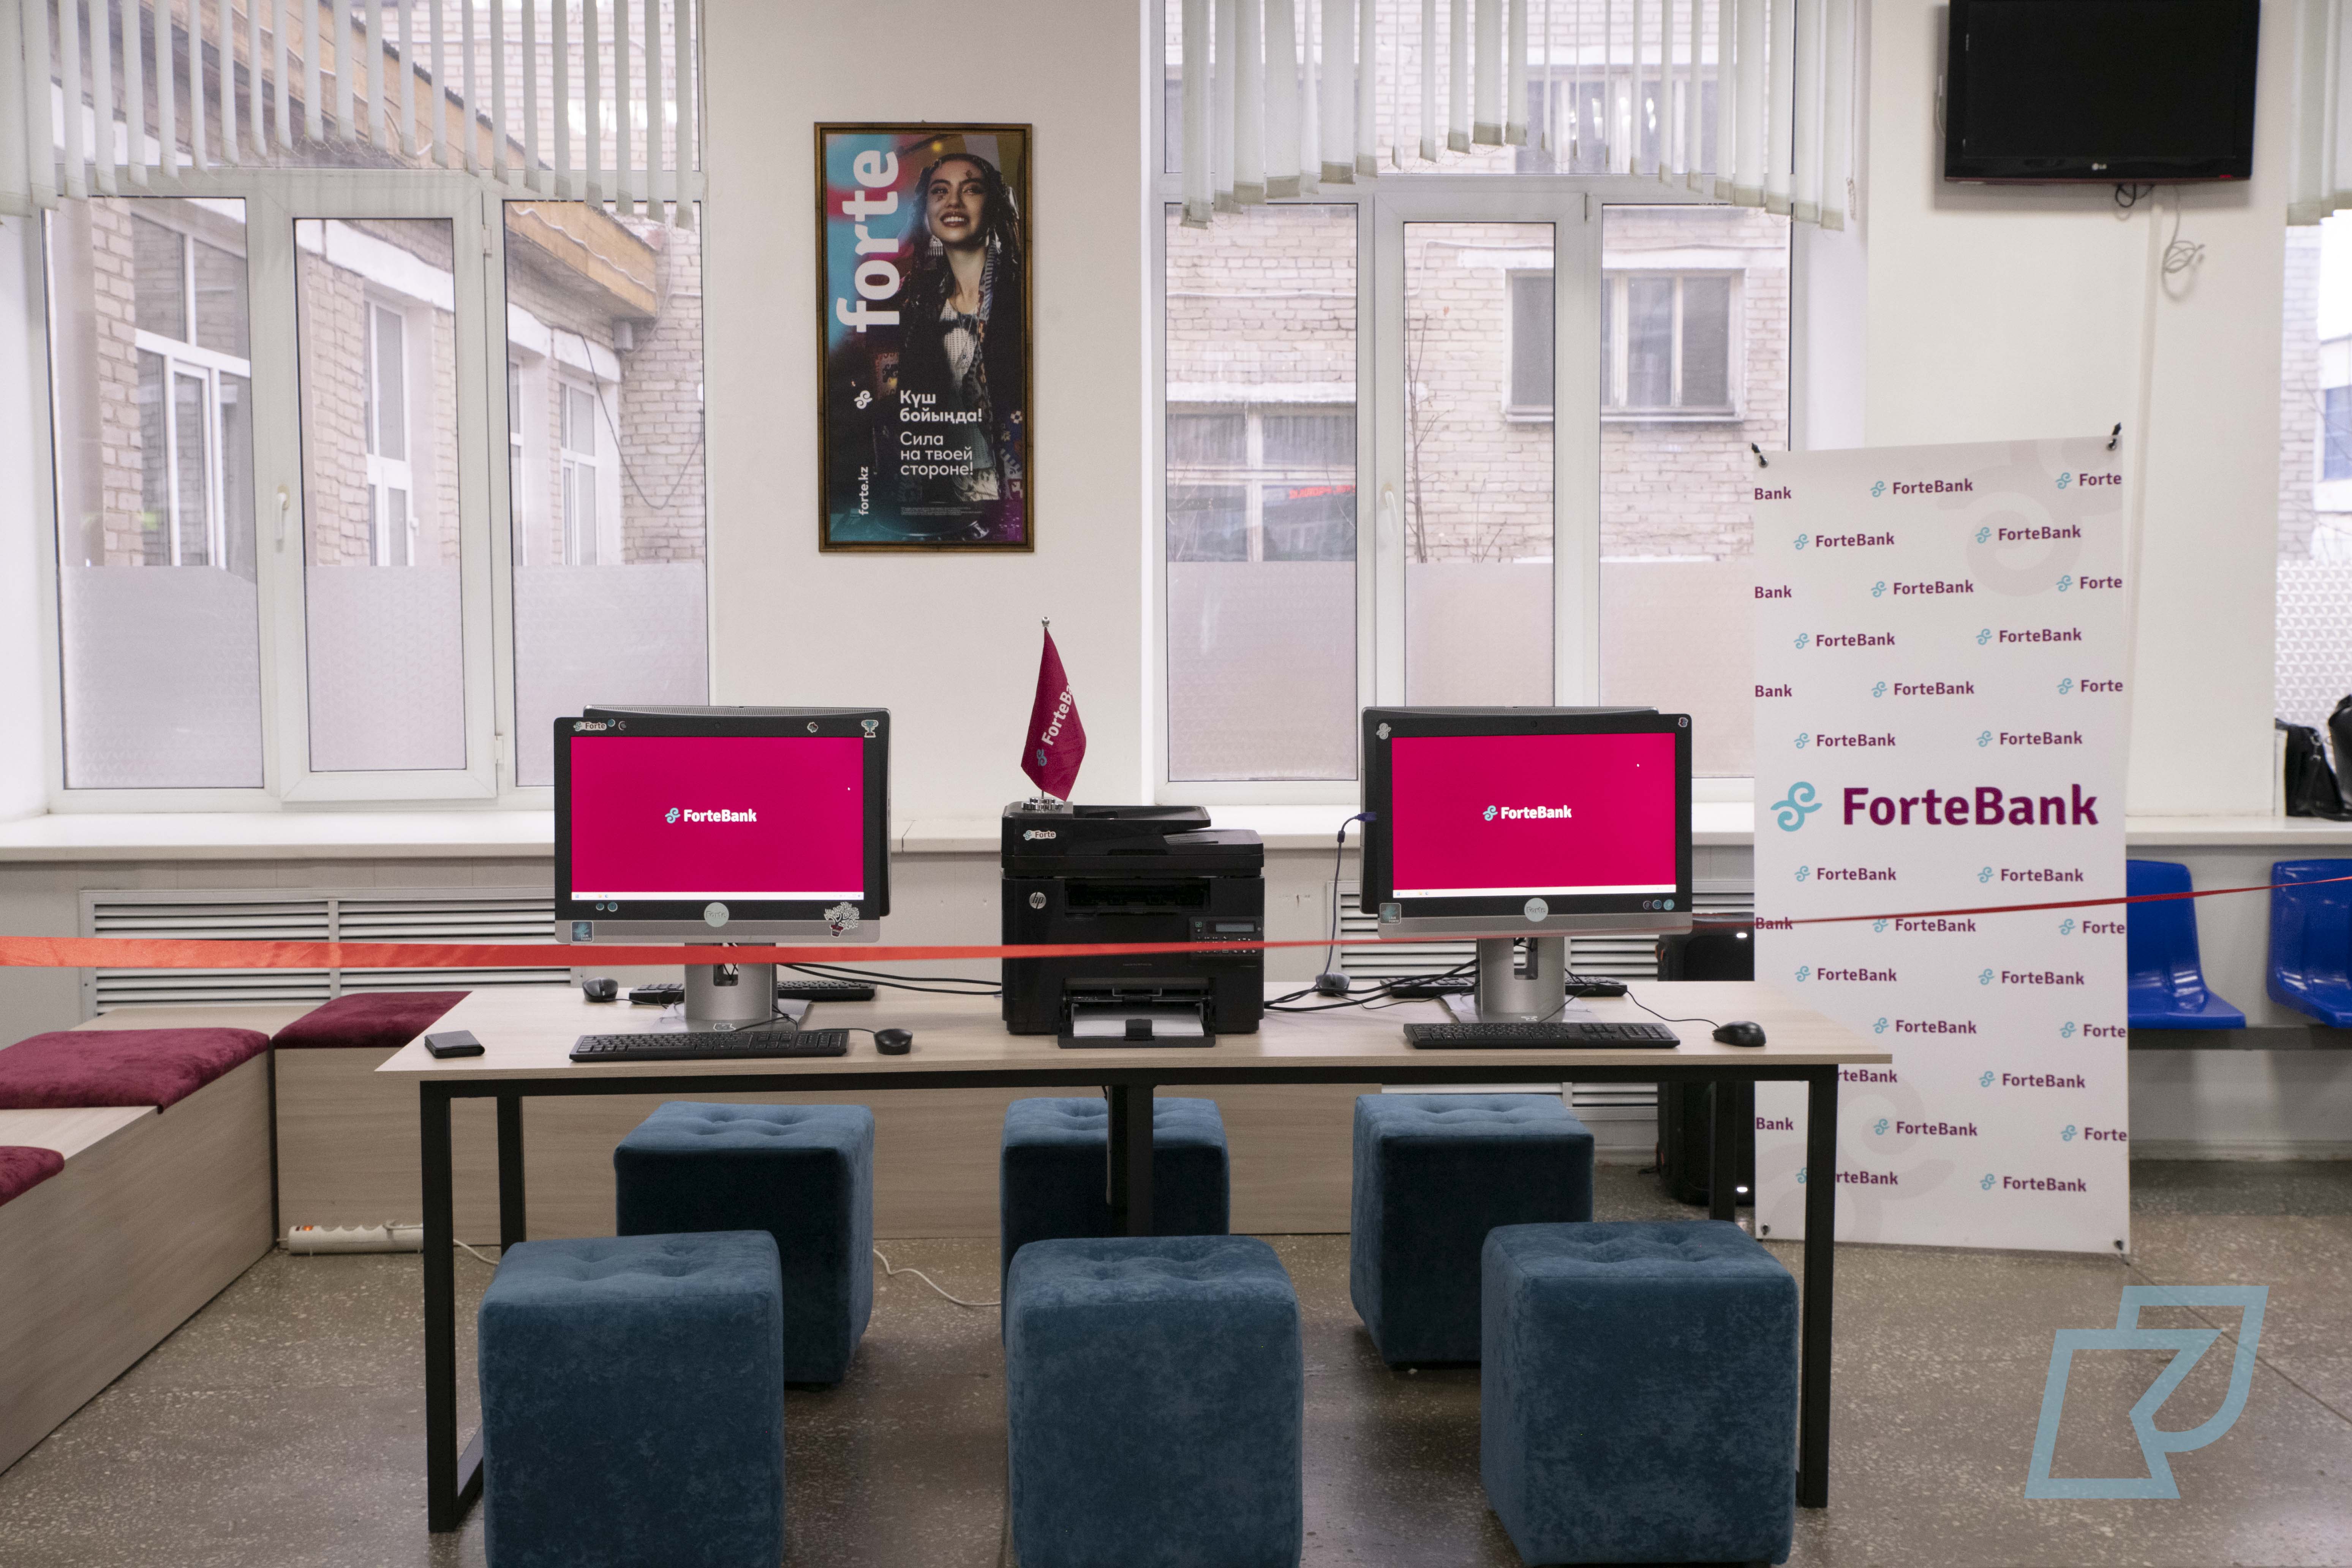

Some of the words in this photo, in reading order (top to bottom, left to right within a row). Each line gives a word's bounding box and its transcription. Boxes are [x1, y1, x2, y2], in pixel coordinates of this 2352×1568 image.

[836, 150, 900, 333] forte
[900, 390, 936, 408] Күш
[900, 407, 982, 424] бойыңда!
[900, 431, 944, 446] Сила
[901, 450, 920, 460] на
[925, 446, 972, 460] твоей
[900, 462, 973, 480] стороне!
[858, 466, 869, 516] forte.kz
[1893, 478, 1973, 495] ForteBank
[1816, 532, 1894, 547] ForteBank
[1999, 525, 2081, 541] ForteBank
[1894, 580, 1974, 595] ForteBank
[1816, 632, 1895, 646] ForteBank
[2000, 628, 2081, 643] ForteBank
[1894, 681, 1974, 695] ForteBank
[1041, 684, 1073, 746] ForteBa
[1817, 733, 1895, 747] ForteBank
[2000, 731, 2082, 745] ForteBank
[1843, 783, 2099, 826] ForteBank
[683, 809, 757, 822] ForteBank
[1501, 805, 1572, 820] ForteBank
[1817, 867, 1896, 880] ForteBank
[2001, 869, 2083, 882] ForteBank
[1032, 892, 1045, 909] hp
[1895, 918, 1976, 932] ForteBank
[1818, 968, 1897, 982] ForteBank
[2002, 971, 2084, 985] ForteBank
[1896, 1020, 1976, 1034] ForteBank
[2002, 1073, 2085, 1088] ForteBank
[1896, 1121, 1977, 1136] ForteBank
[1836, 1171, 1898, 1185] rteBank
[2003, 1176, 2085, 1192] ForteBank
